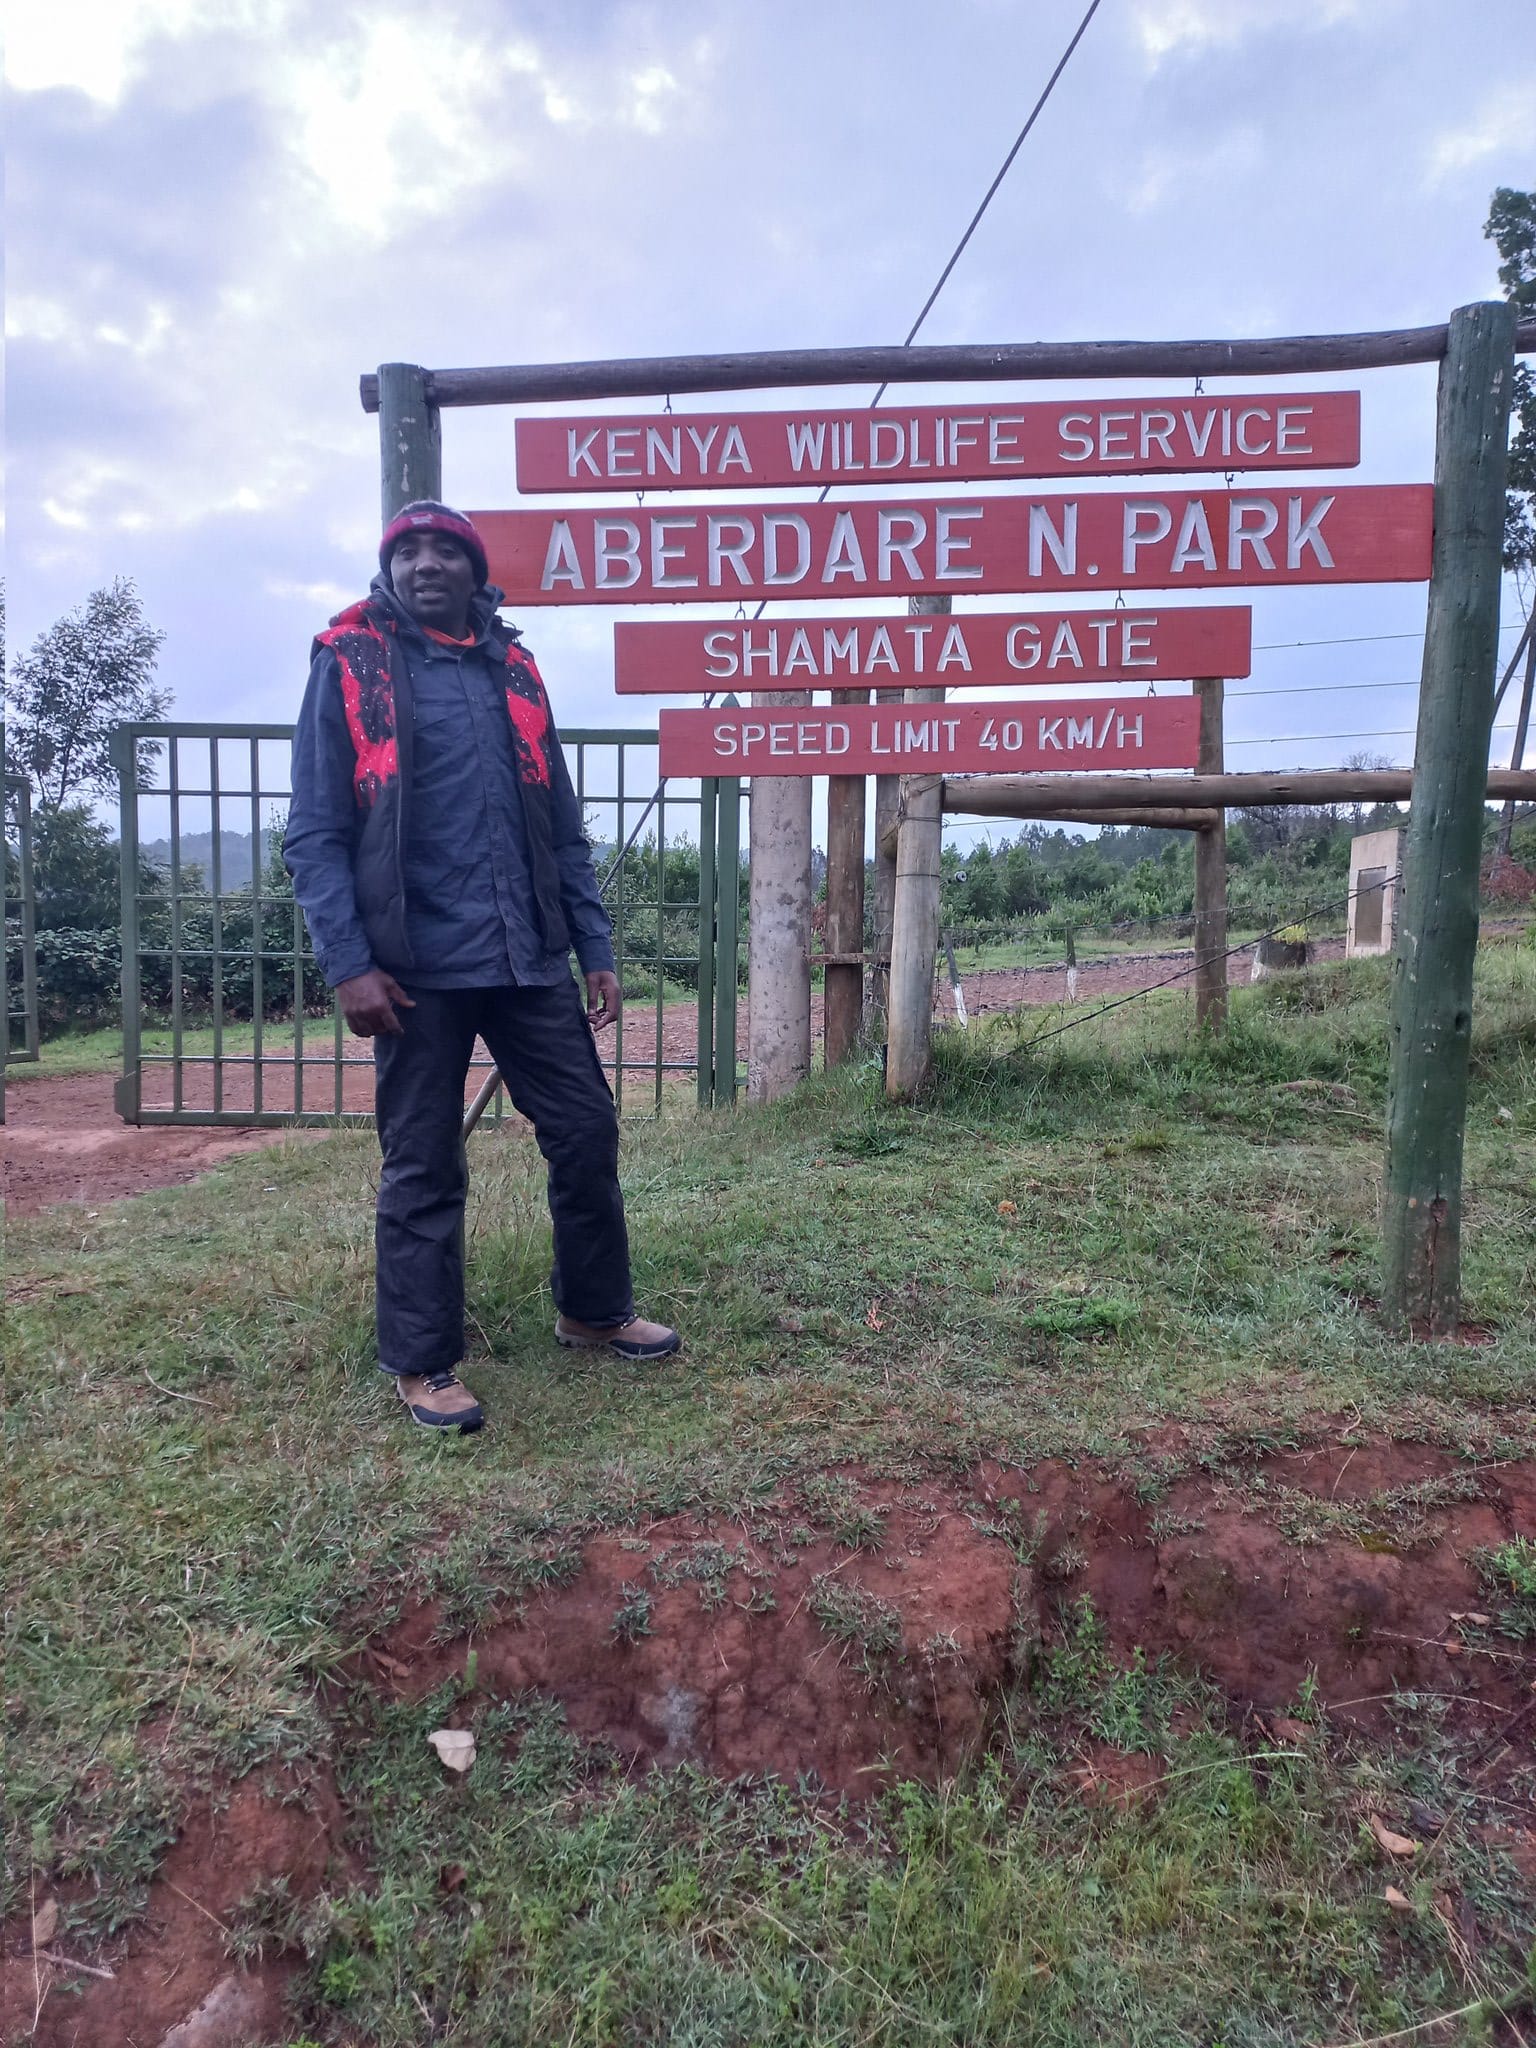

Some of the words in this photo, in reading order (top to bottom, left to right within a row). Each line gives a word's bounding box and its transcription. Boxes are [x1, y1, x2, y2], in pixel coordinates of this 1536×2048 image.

[567, 424, 753, 477] KENYA
[786, 415, 1025, 471] WILDLIFE
[1058, 406, 1314, 461] SERVICE
[540, 505, 984, 591] ABERDARE
[1028, 502, 1100, 577] N.
[1122, 496, 1336, 574] PARK
[703, 623, 973, 678] SHAMATA
[1006, 616, 1158, 670] GATE
[712, 720, 850, 757] SPEED
[870, 718, 961, 753] LIMIT
[979, 717, 1023, 751] 40
[1038, 706, 1144, 750] KM/H
